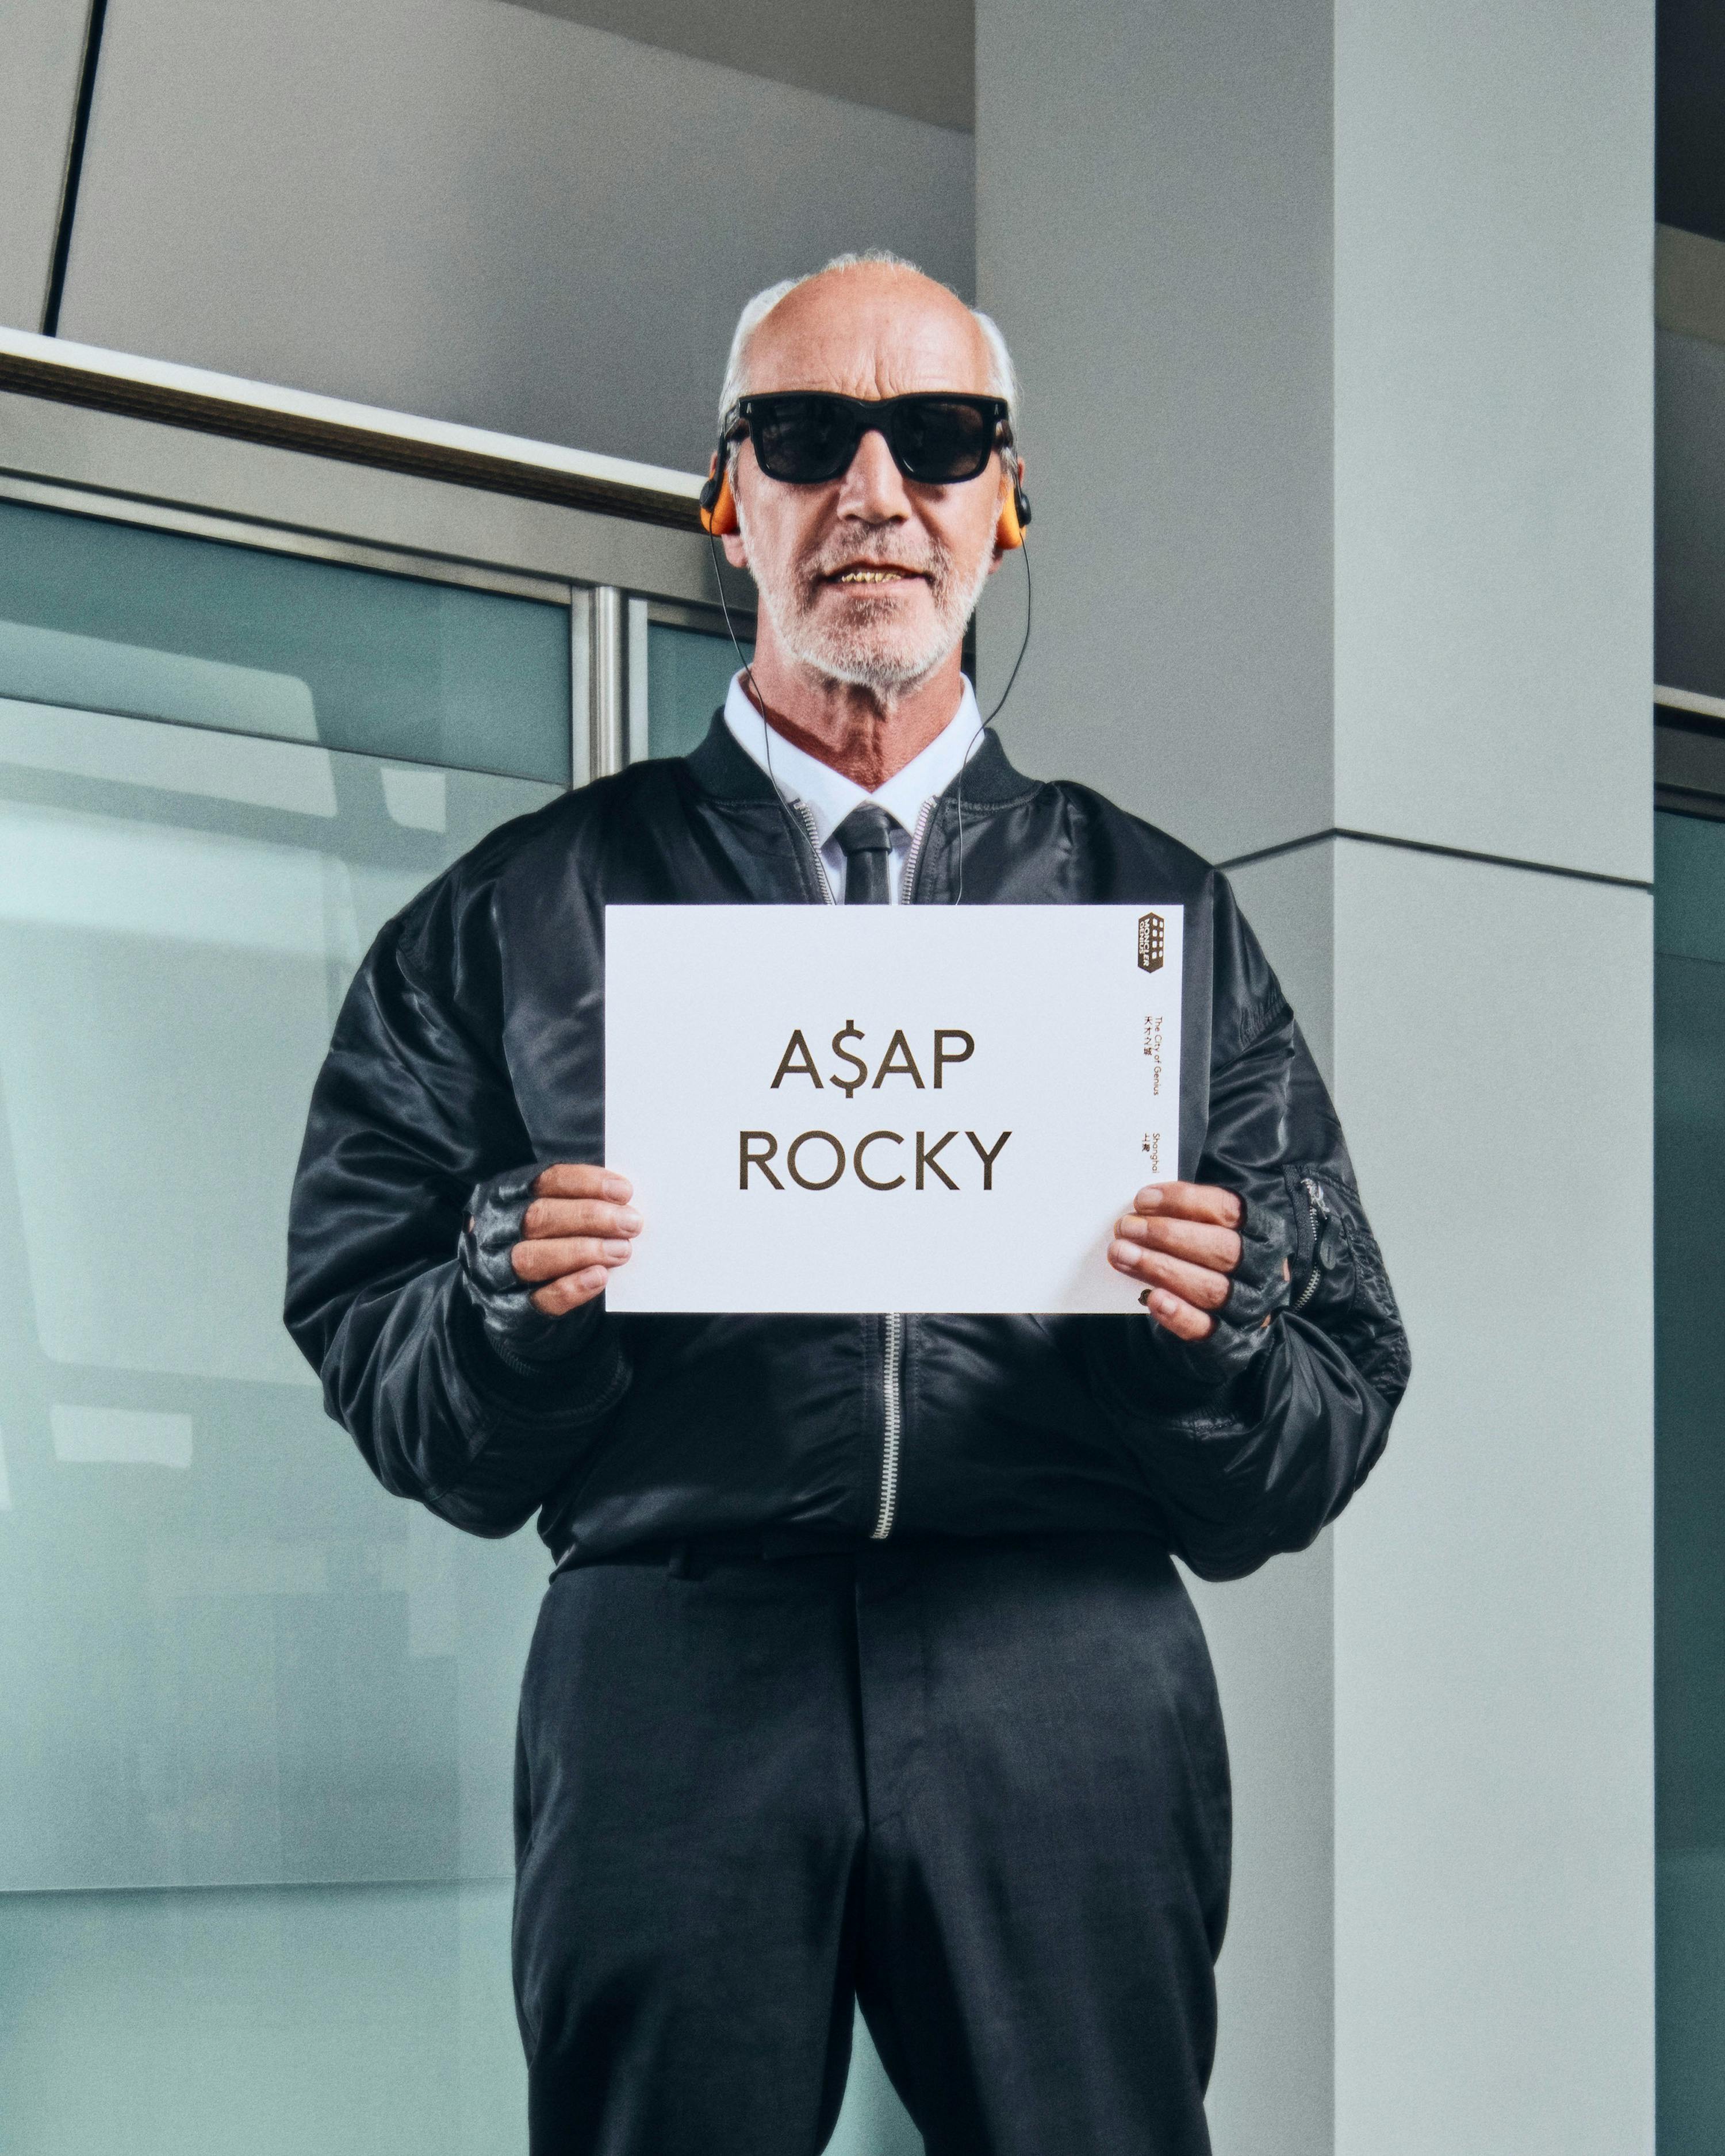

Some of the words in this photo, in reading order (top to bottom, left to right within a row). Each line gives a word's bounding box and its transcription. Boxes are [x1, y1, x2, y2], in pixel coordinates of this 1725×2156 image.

[1144, 1016, 1152, 1056] 天才之城
[1155, 1016, 1163, 1032] The
[1152, 1034, 1162, 1053] City
[770, 1020, 975, 1099] A$AP
[1154, 1054, 1162, 1064] of
[1153, 1066, 1162, 1096] Genius
[1142, 1133, 1150, 1152] 上海
[1150, 1133, 1160, 1173] Shanghai
[740, 1131, 1013, 1191] ROCKY
